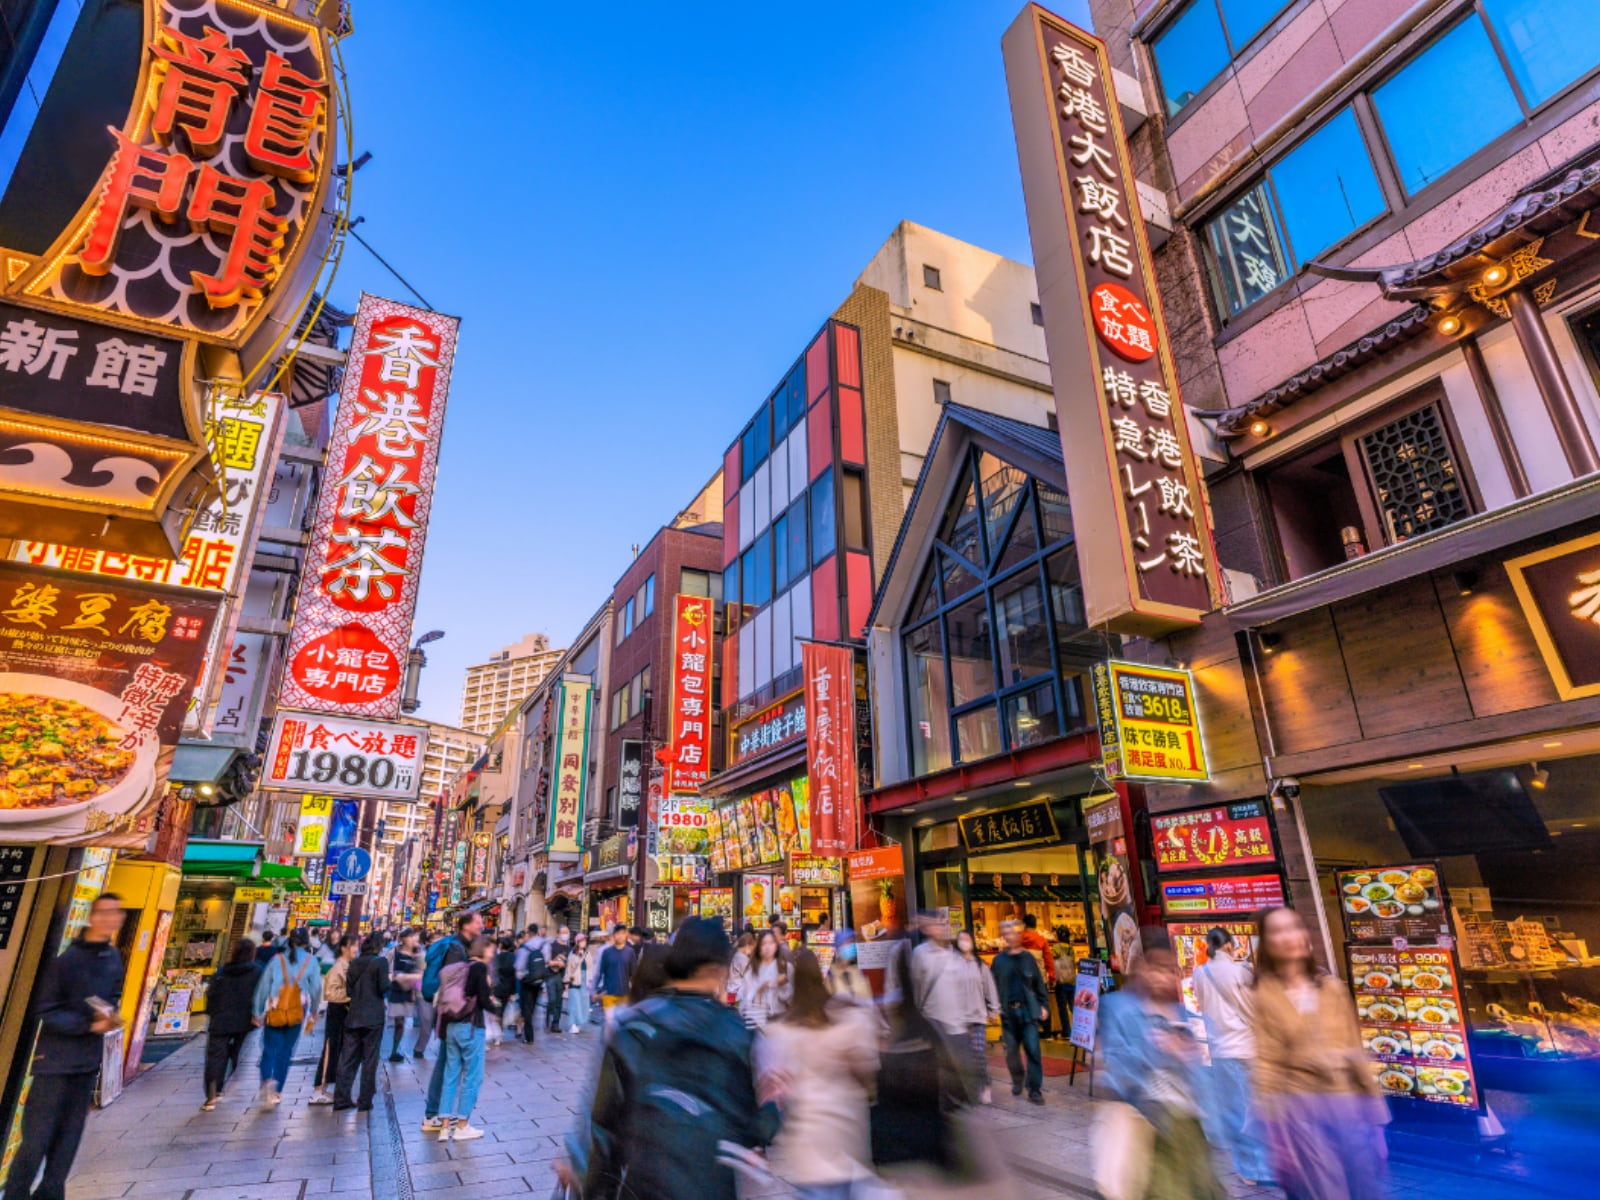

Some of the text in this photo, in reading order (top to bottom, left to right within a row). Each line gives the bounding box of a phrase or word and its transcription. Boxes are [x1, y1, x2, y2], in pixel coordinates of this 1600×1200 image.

[80, 25, 330, 305] 龍門
[1053, 42, 1133, 277] 香港大飯店
[1096, 289, 1146, 322] 食べ
[1101, 315, 1154, 353] 放題
[0, 319, 168, 397] 新館
[320, 325, 445, 601] 香港飲茶
[1102, 366, 1167, 573] 特急レーン
[1138, 379, 1205, 575] 香港飲茶
[301, 668, 387, 694] 専門店
[306, 643, 391, 671] 小籠包
[678, 630, 706, 765] 小籠包専門店
[308, 724, 418, 760] 食べ放題
[1124, 726, 1182, 750] 味で勝負
[661, 800, 678, 812] 2F
